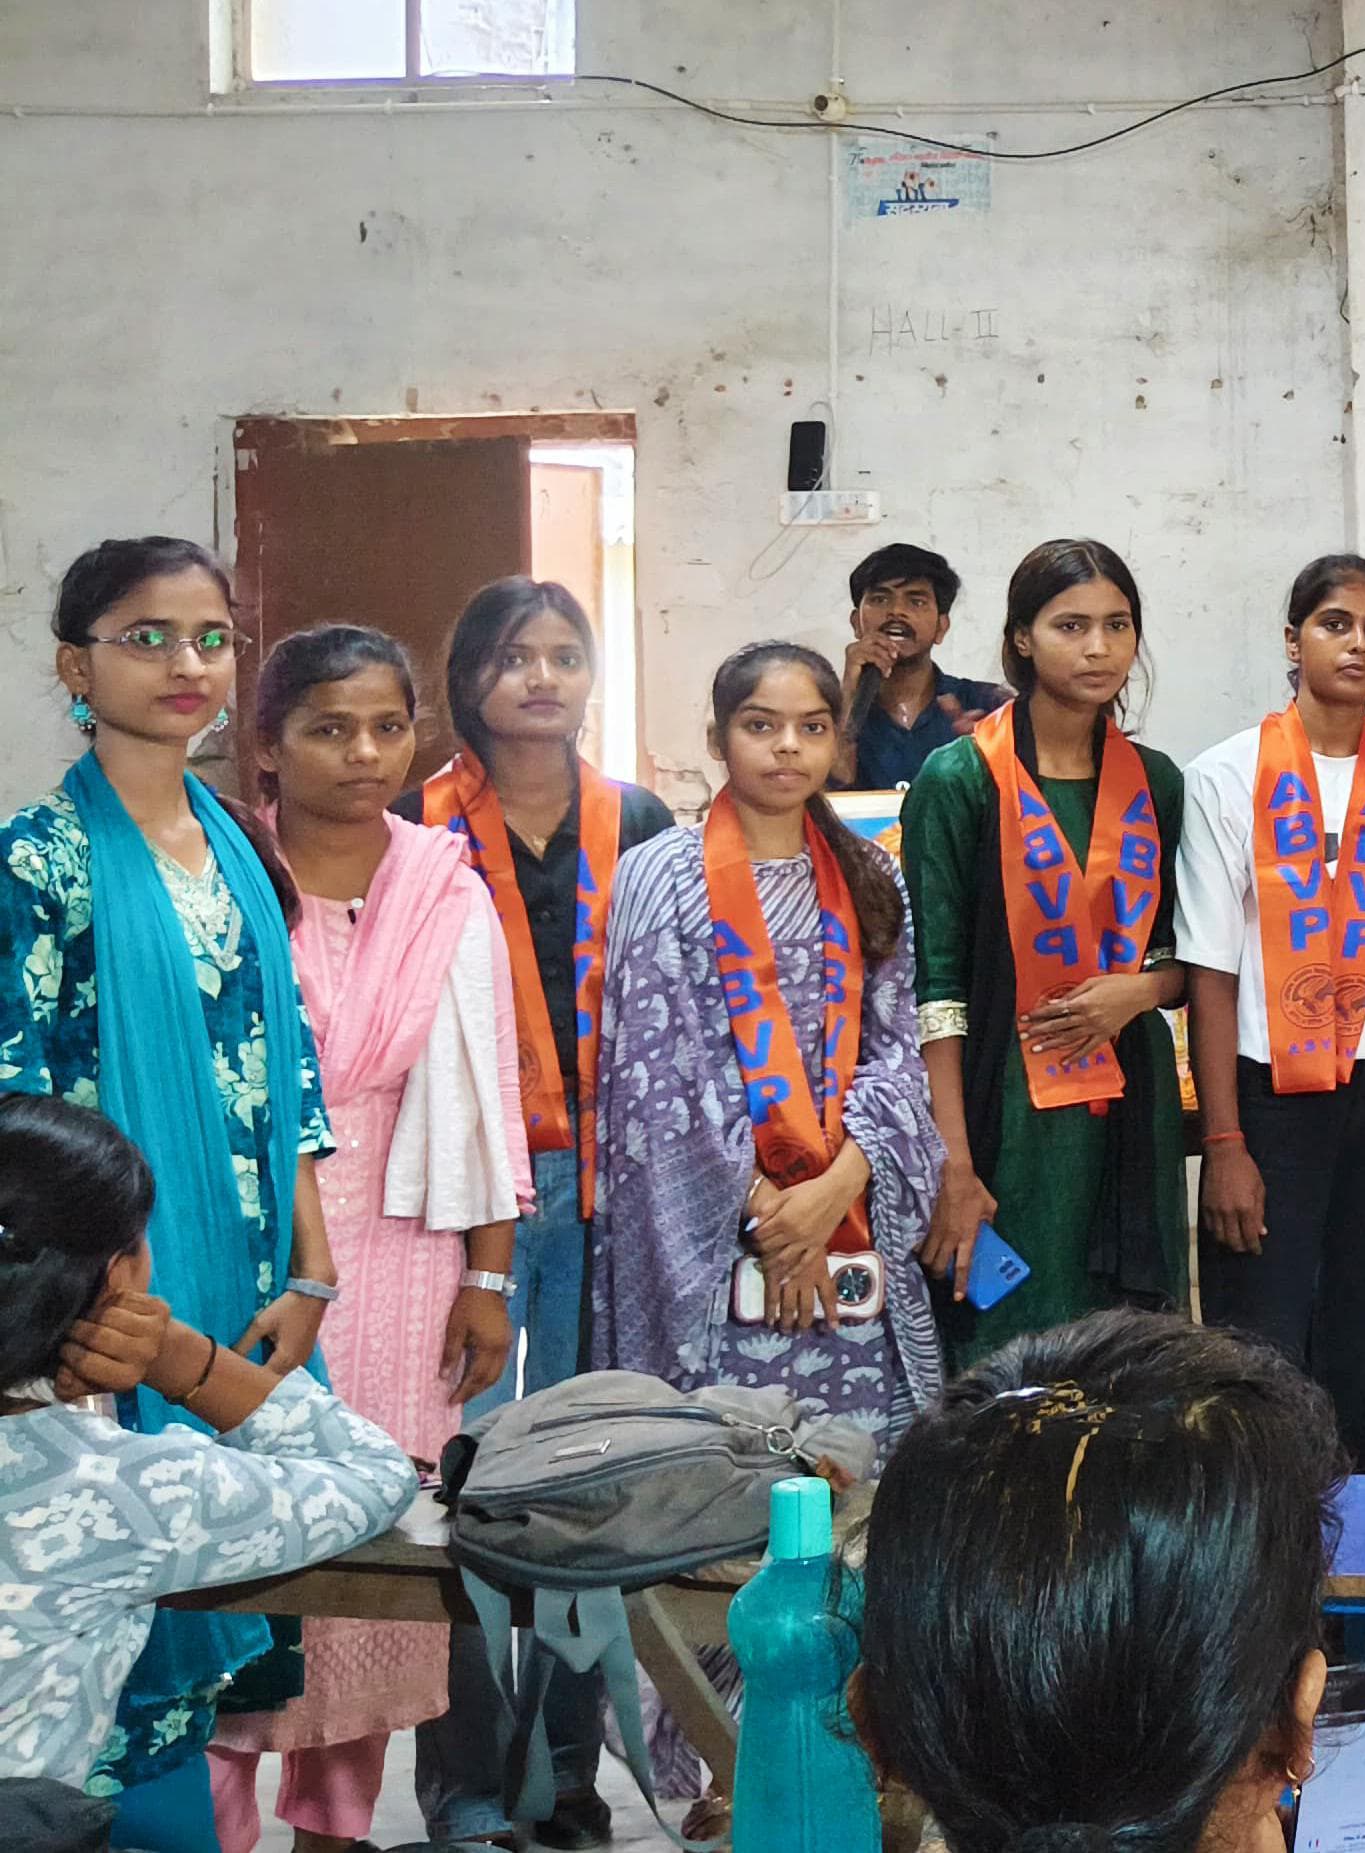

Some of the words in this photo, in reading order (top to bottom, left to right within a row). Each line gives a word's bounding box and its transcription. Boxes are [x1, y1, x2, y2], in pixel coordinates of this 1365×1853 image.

[1098, 789, 1160, 972] ABVP
[1267, 771, 1331, 952] ABVP
[712, 920, 791, 1126] ABVP
